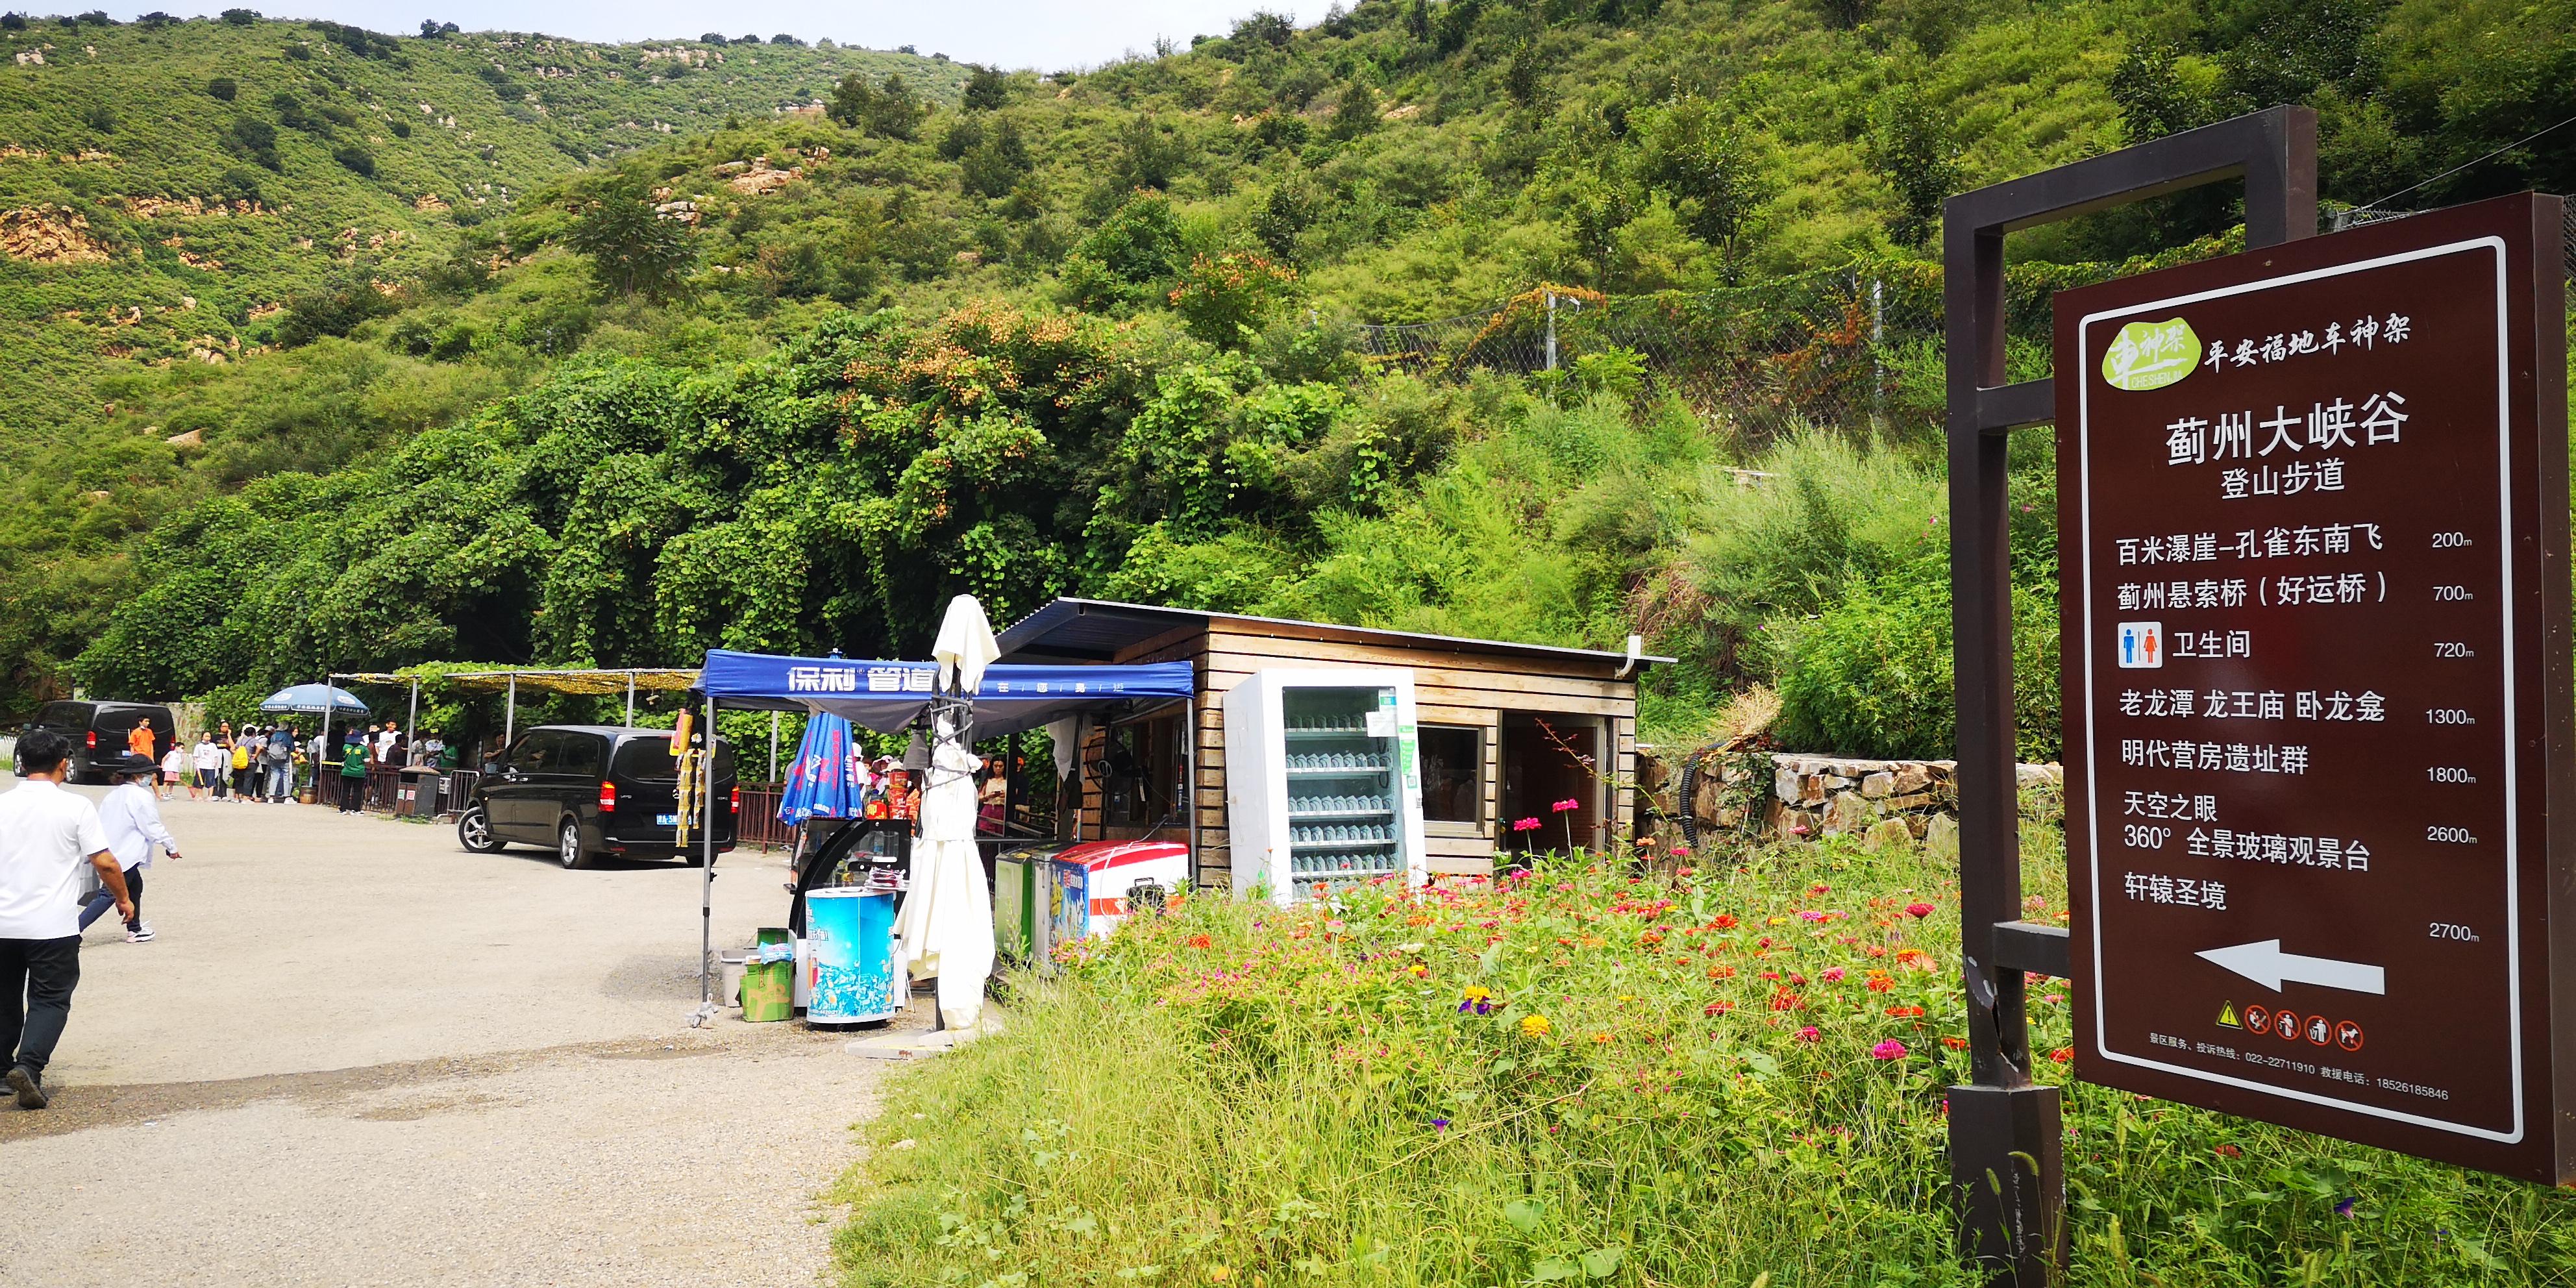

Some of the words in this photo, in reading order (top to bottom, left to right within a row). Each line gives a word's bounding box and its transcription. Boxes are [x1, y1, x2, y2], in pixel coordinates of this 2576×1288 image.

[2204, 312, 2412, 373] 平安福地车神架
[2166, 391, 2409, 466] 蓟州大峡谷
[2220, 457, 2346, 500] 登山步道
[2432, 532, 2472, 548] 200m
[2433, 585, 2473, 601] 700m
[2172, 629, 2251, 659] 卫生间
[2434, 642, 2474, 658] 720m
[2118, 688, 2195, 718] 老龙潭
[2203, 689, 2285, 720] 龙王庙
[2296, 690, 2386, 723] 卧龙龛
[2425, 709, 2475, 724] 1300m
[2122, 739, 2309, 776] 明代营房遗址群
[2427, 767, 2476, 783] 1800m
[2124, 791, 2218, 823] 天空之眼
[2124, 824, 2172, 850] 360°
[2186, 826, 2371, 872] 全景玻璃观景台
[2427, 826, 2478, 844] 2600m
[2124, 871, 2227, 911] 轩辕圣境
[2429, 923, 2480, 942] 2700m
[2245, 1052, 2316, 1075] 022-22711910
[2376, 1078, 2449, 1100] 18526185846
